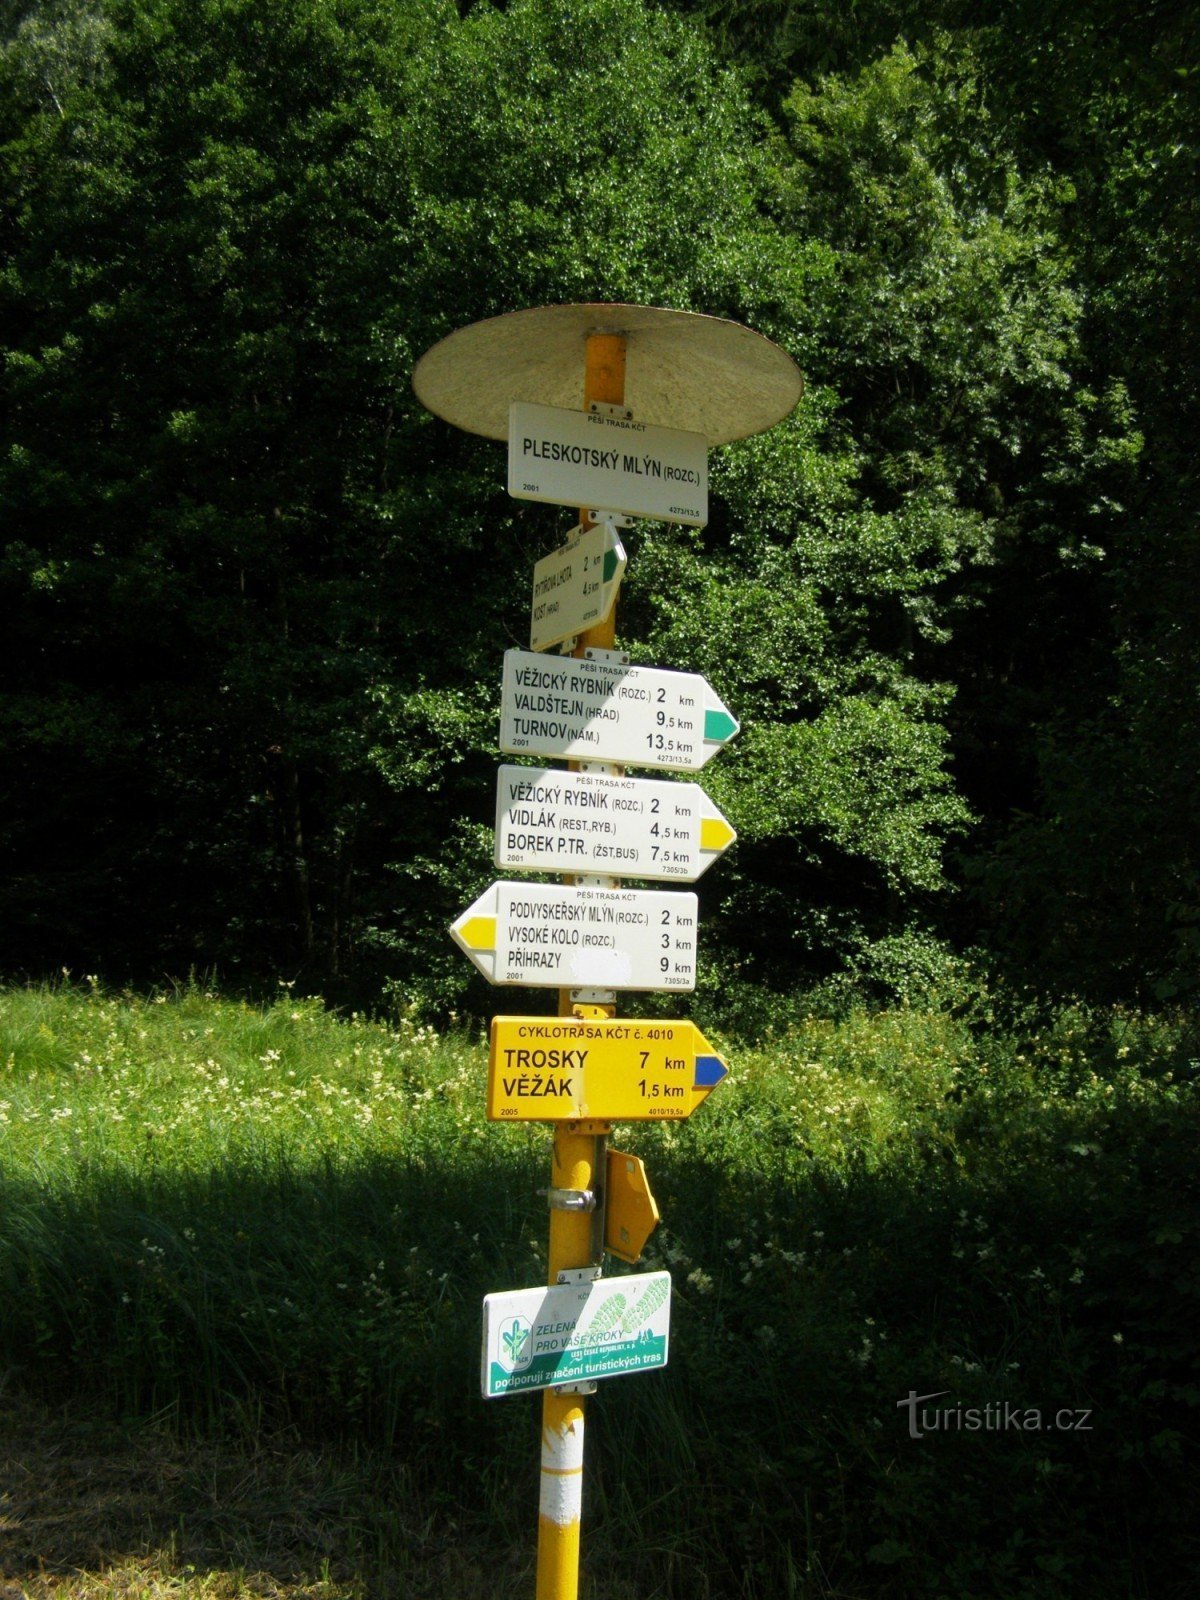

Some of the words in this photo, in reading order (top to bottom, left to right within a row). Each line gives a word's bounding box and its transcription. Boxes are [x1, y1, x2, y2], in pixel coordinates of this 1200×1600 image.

[607, 419, 630, 428] TRASA
[632, 423, 646, 432] KČT
[523, 438, 619, 470] PLESKOTSKÝ
[624, 455, 660, 478] MLÝN
[664, 466, 700, 486] (ROZC.)
[523, 484, 539, 492] 2001
[669, 506, 700, 518] 4273/13,5
[584, 556, 588, 572] 2
[594, 556, 600, 565] km
[592, 582, 599, 592] km
[600, 666, 623, 676] TRASA
[625, 670, 639, 678] KČT
[516, 667, 567, 689] VĚŽICKÝ
[571, 676, 614, 696] RYBNÍK
[618, 687, 651, 702] (ROZC.)
[657, 688, 666, 702] 2
[680, 695, 694, 706] km
[515, 693, 583, 716] VALDŠTEJN
[586, 707, 619, 722] (HRAD)
[656, 712, 674, 728] 9,5
[677, 718, 693, 730] km
[512, 738, 528, 746] 2001
[514, 718, 567, 738] TURNOV
[646, 734, 674, 750] 13,5
[677, 740, 692, 752] km
[594, 778, 619, 788] TRASA
[621, 780, 636, 788] KČT
[510, 782, 560, 802] VĚŽICKÝ
[564, 790, 608, 809] RYBNÍK
[612, 798, 643, 814] (ROZC.)
[651, 798, 659, 814] 2
[675, 806, 691, 816] km
[509, 808, 556, 828] VIDLÁK
[650, 823, 670, 839] 4,5
[674, 829, 690, 840] km
[508, 834, 553, 852] BOREK
[558, 838, 588, 854] P.TR.
[651, 846, 670, 862] 7,5
[674, 852, 689, 862] km
[507, 854, 523, 862] 2001
[662, 866, 688, 874] 7305/3b
[596, 892, 620, 900] TRASA
[622, 892, 637, 901] KČT
[510, 902, 586, 921] PODVYSKEŘSKÝ
[589, 904, 614, 922] MLÝN
[616, 912, 648, 925] (ROZC.)
[661, 910, 670, 925] 2
[676, 916, 692, 926] km
[509, 924, 549, 944] VYSOKÉ
[552, 929, 579, 945] KOLO
[582, 934, 615, 948] (ROZC.)
[661, 934, 670, 948] 3
[676, 939, 691, 950] km
[508, 948, 561, 968] PŘÍHRAZY
[660, 957, 669, 972] 9
[675, 963, 691, 974] km
[506, 972, 523, 980] 2001
[518, 1027, 602, 1038] CYKLOTRASA
[606, 1026, 630, 1039] KČT
[634, 1030, 643, 1040] č.
[648, 1030, 672, 1040] 4010
[504, 1050, 588, 1068] TROSKY
[640, 1052, 649, 1068] 7
[665, 1057, 684, 1069] km
[503, 1074, 572, 1096] VĚŽÁK
[638, 1080, 659, 1098] 1,5
[664, 1084, 684, 1096] km
[649, 1108, 683, 1116] 4010/19,5a
[536, 1319, 576, 1336] ZELENÁ
[536, 1340, 558, 1352] PRO
[561, 1334, 585, 1349] VAŠE
[588, 1329, 624, 1344] KROKY
[495, 1371, 544, 1389] podporují
[546, 1366, 582, 1380] značení
[586, 1354, 641, 1371] turistických
[643, 1352, 662, 1363] tras
